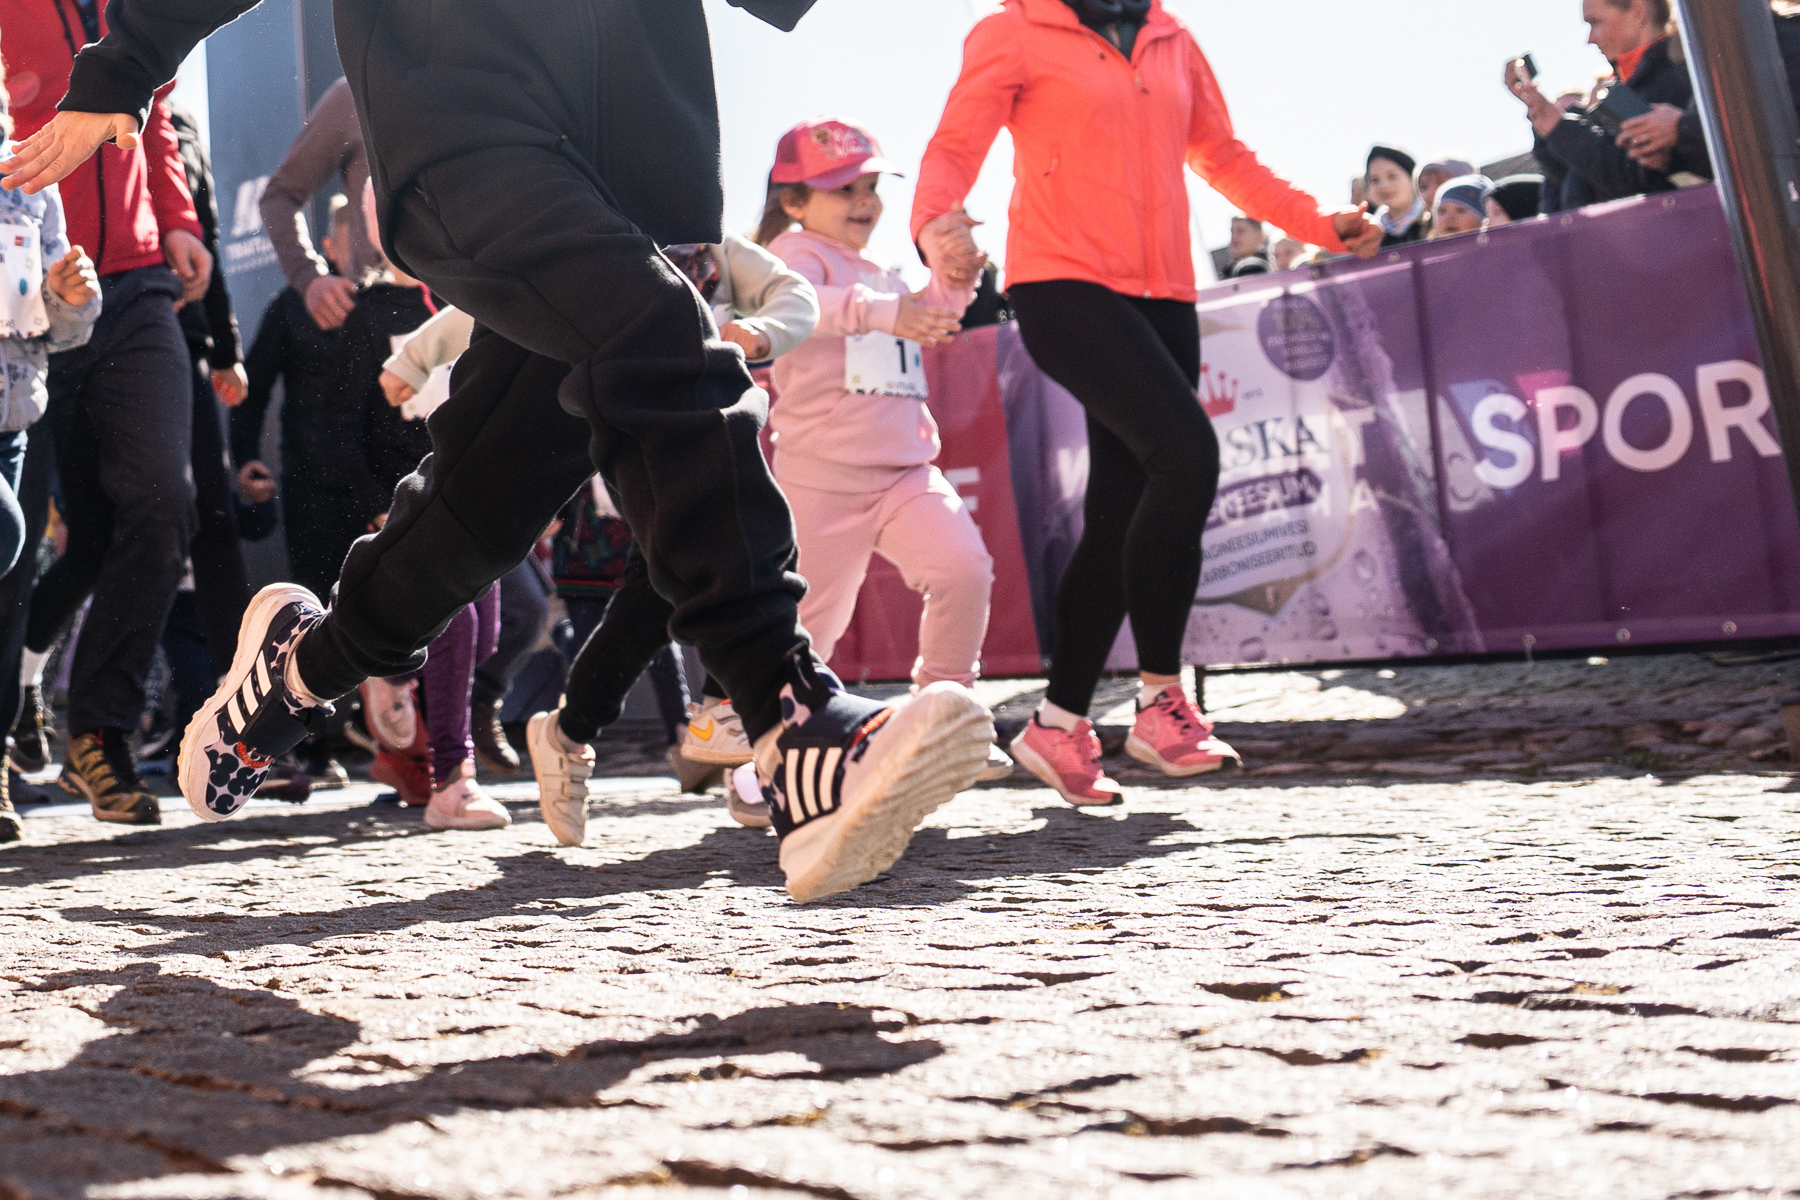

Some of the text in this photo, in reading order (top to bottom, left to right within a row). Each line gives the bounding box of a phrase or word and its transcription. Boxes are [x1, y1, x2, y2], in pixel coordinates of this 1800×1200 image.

[896, 339, 907, 374] 1
[1224, 414, 1330, 471] SKA
[1471, 360, 1782, 490] SPOR
